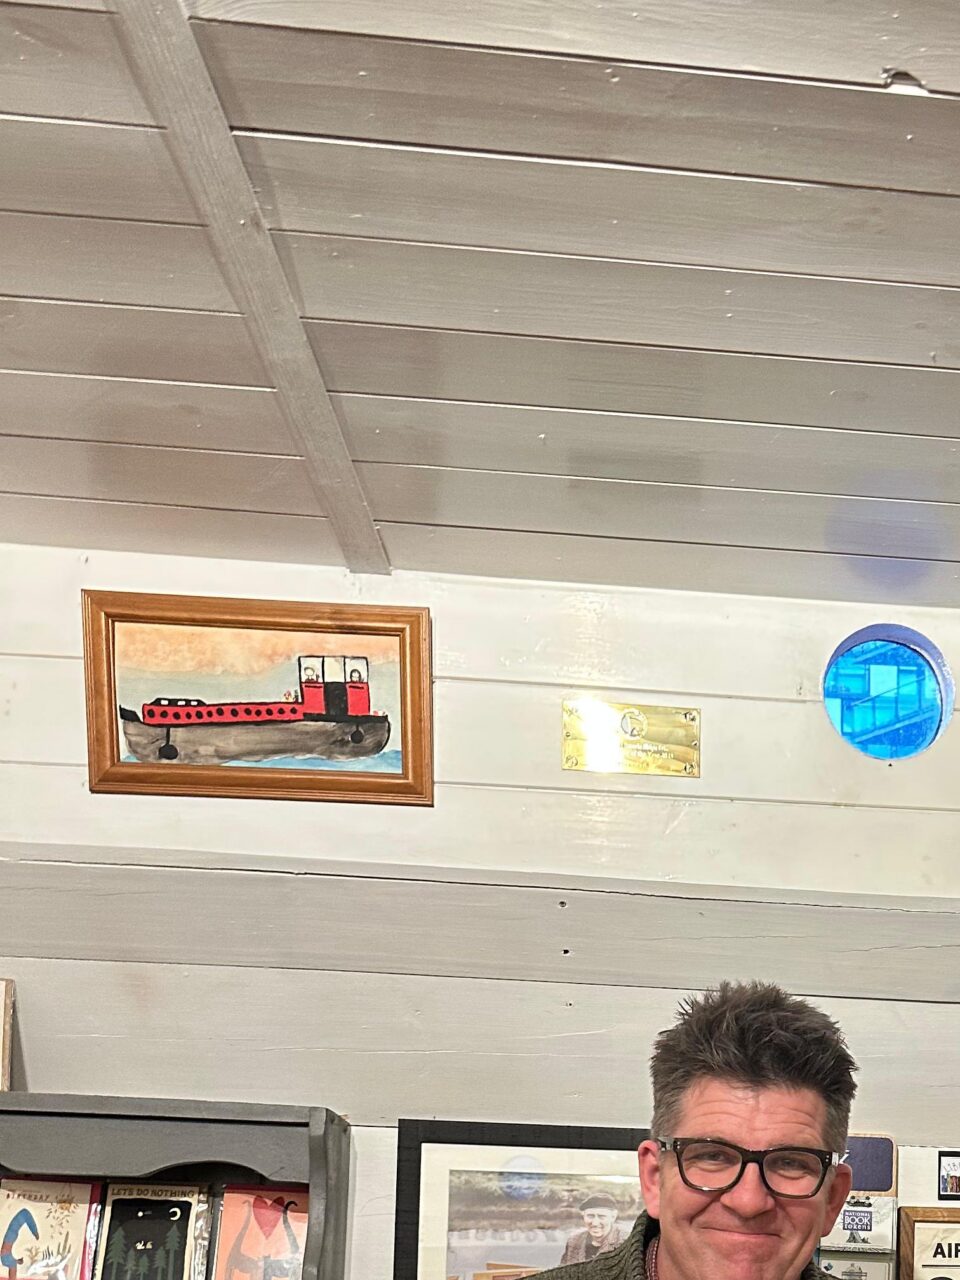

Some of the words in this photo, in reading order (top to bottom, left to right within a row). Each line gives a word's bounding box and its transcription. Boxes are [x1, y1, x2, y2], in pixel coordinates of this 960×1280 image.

[136, 1188, 148, 1196] DO
[150, 1189, 195, 1198] NOTHING
[844, 1215, 871, 1225] BOOK
